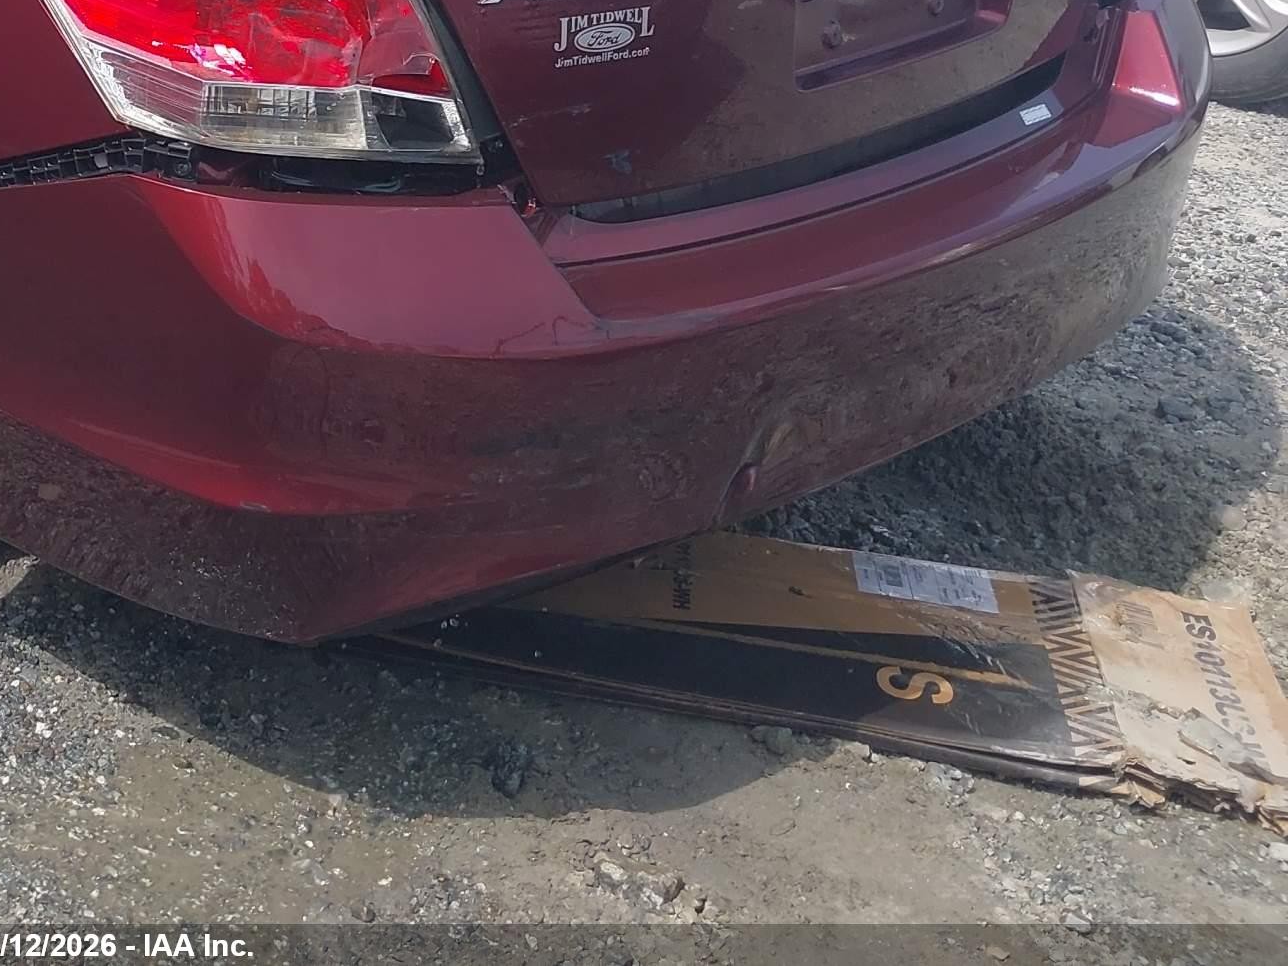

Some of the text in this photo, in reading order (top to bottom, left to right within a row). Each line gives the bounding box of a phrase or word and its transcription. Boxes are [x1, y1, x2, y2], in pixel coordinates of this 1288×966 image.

[554, 6, 655, 52] JIM TIDWELL
[588, 31, 624, 47] Ford
[877, 666, 954, 704] S
